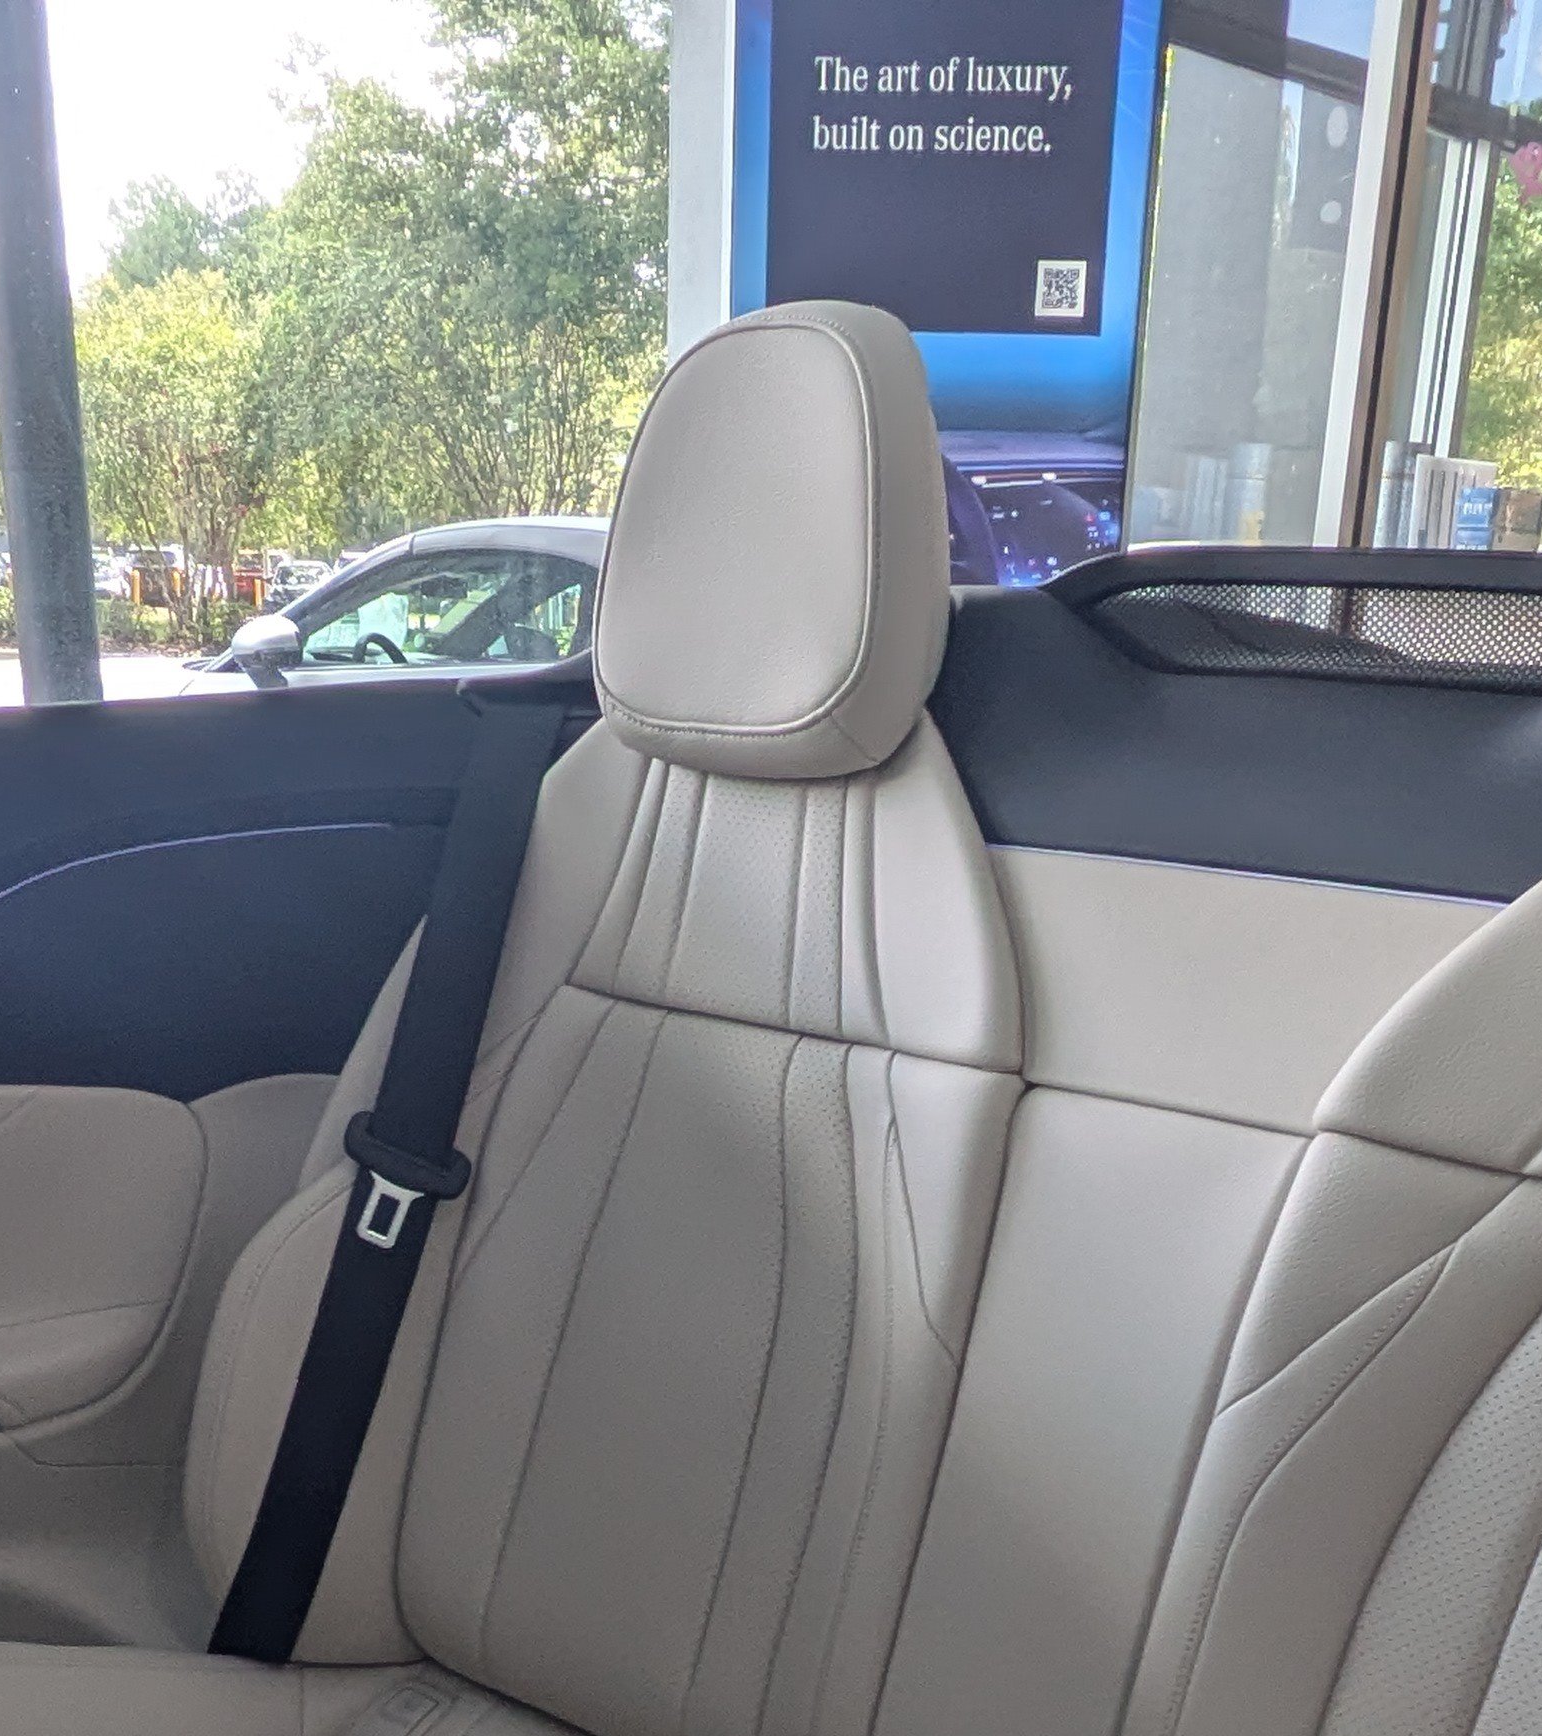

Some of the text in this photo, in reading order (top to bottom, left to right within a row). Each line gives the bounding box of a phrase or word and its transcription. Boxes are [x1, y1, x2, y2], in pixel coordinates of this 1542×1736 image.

[813, 56, 1072, 102] The art of luxury,
[812, 114, 1052, 152] built on science.
